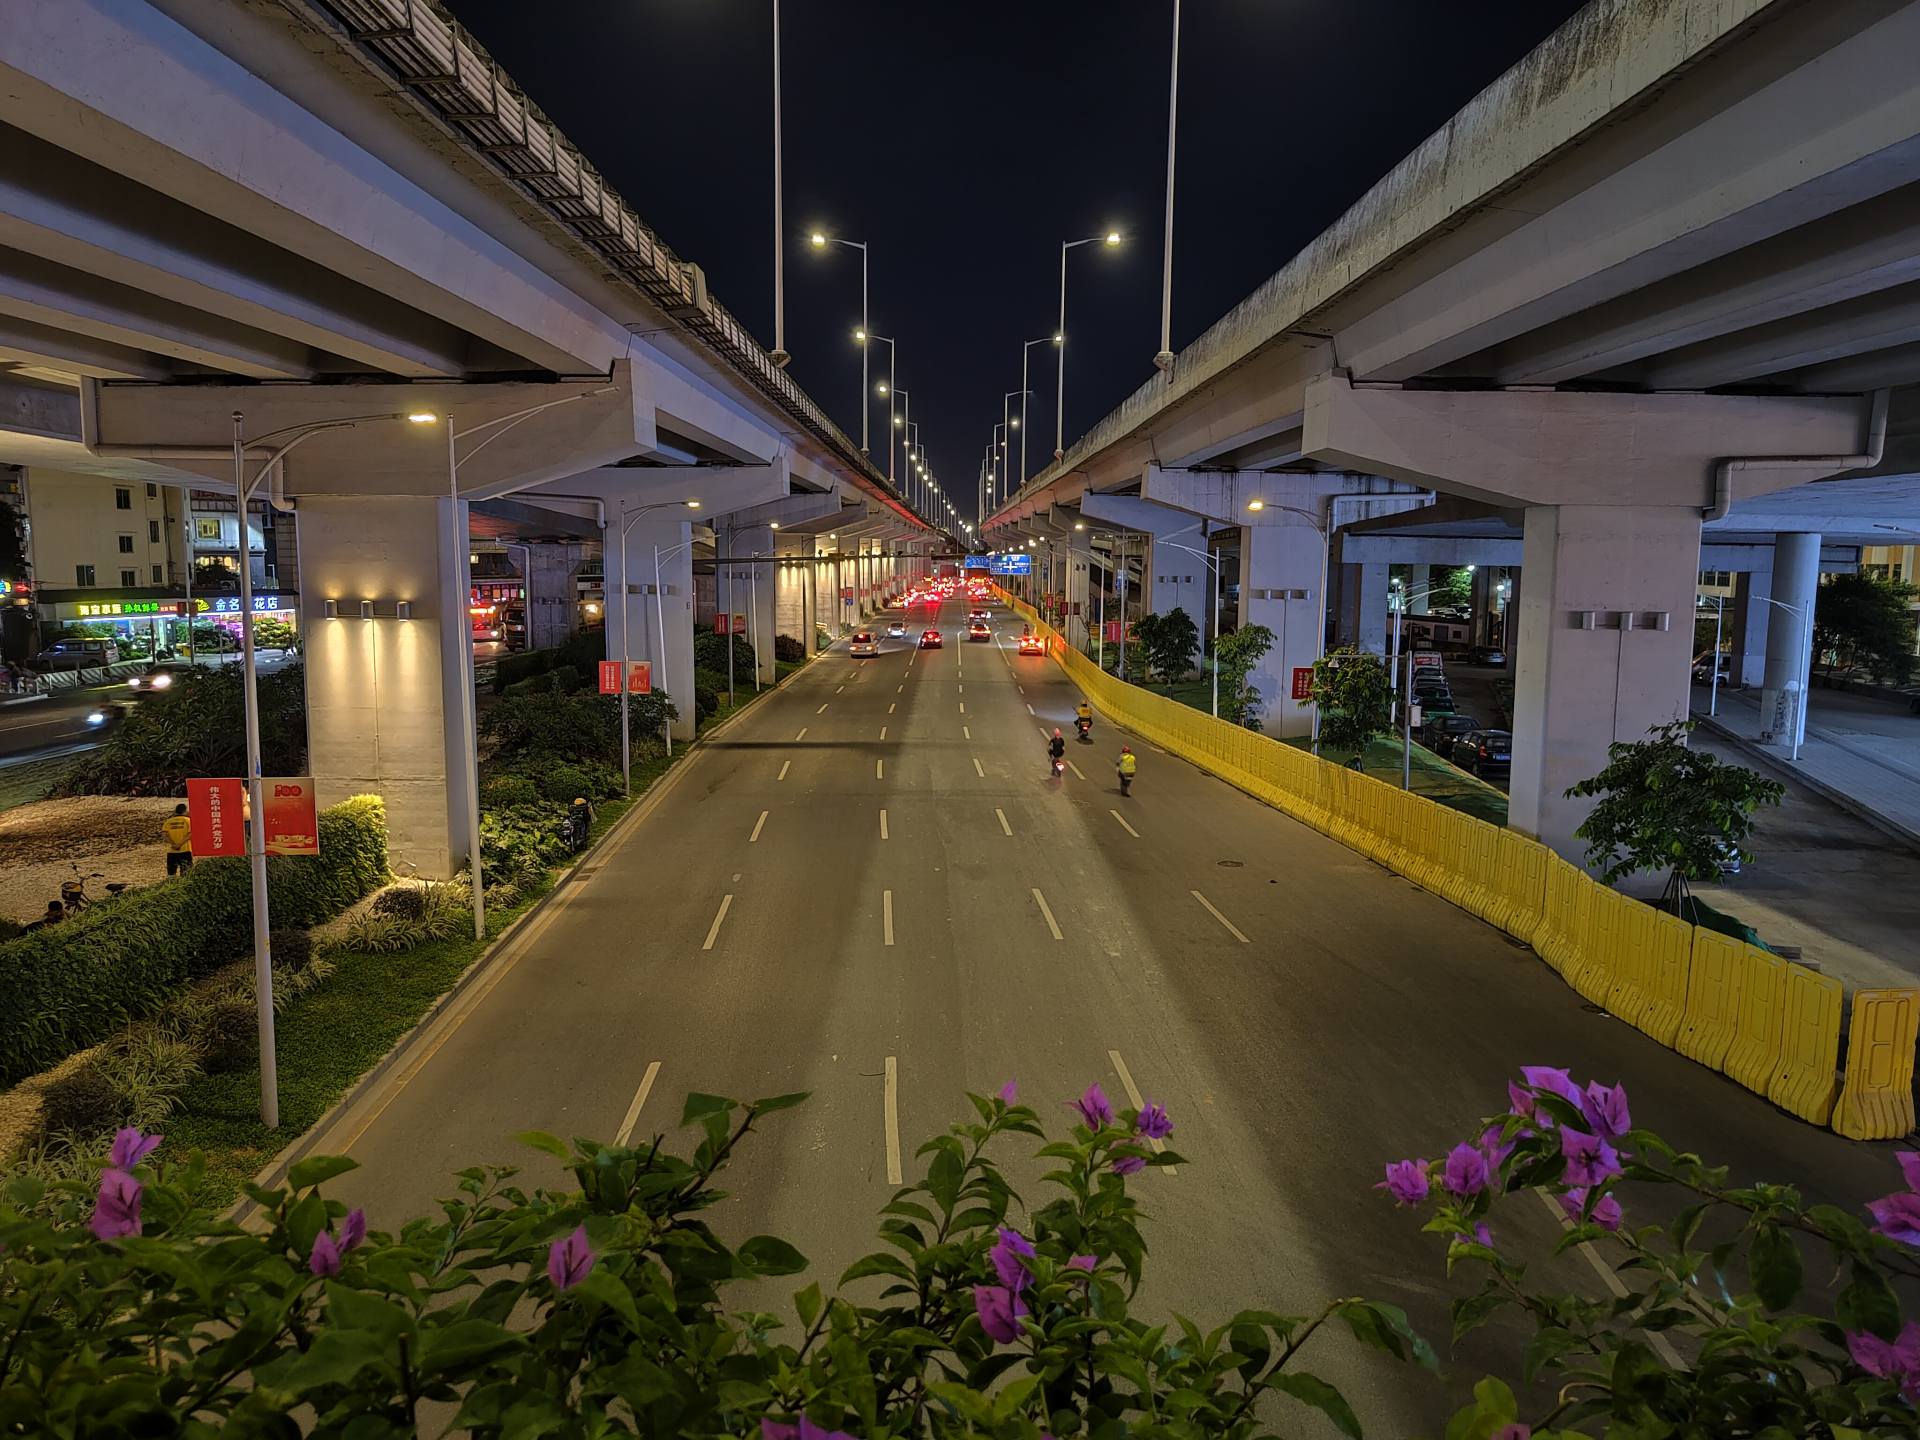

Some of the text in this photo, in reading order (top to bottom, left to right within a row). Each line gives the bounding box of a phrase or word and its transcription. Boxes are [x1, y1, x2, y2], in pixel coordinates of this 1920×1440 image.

[215, 597, 278, 611] 金名花店
[209, 786, 223, 849] 伟大的中国共产党万岁
